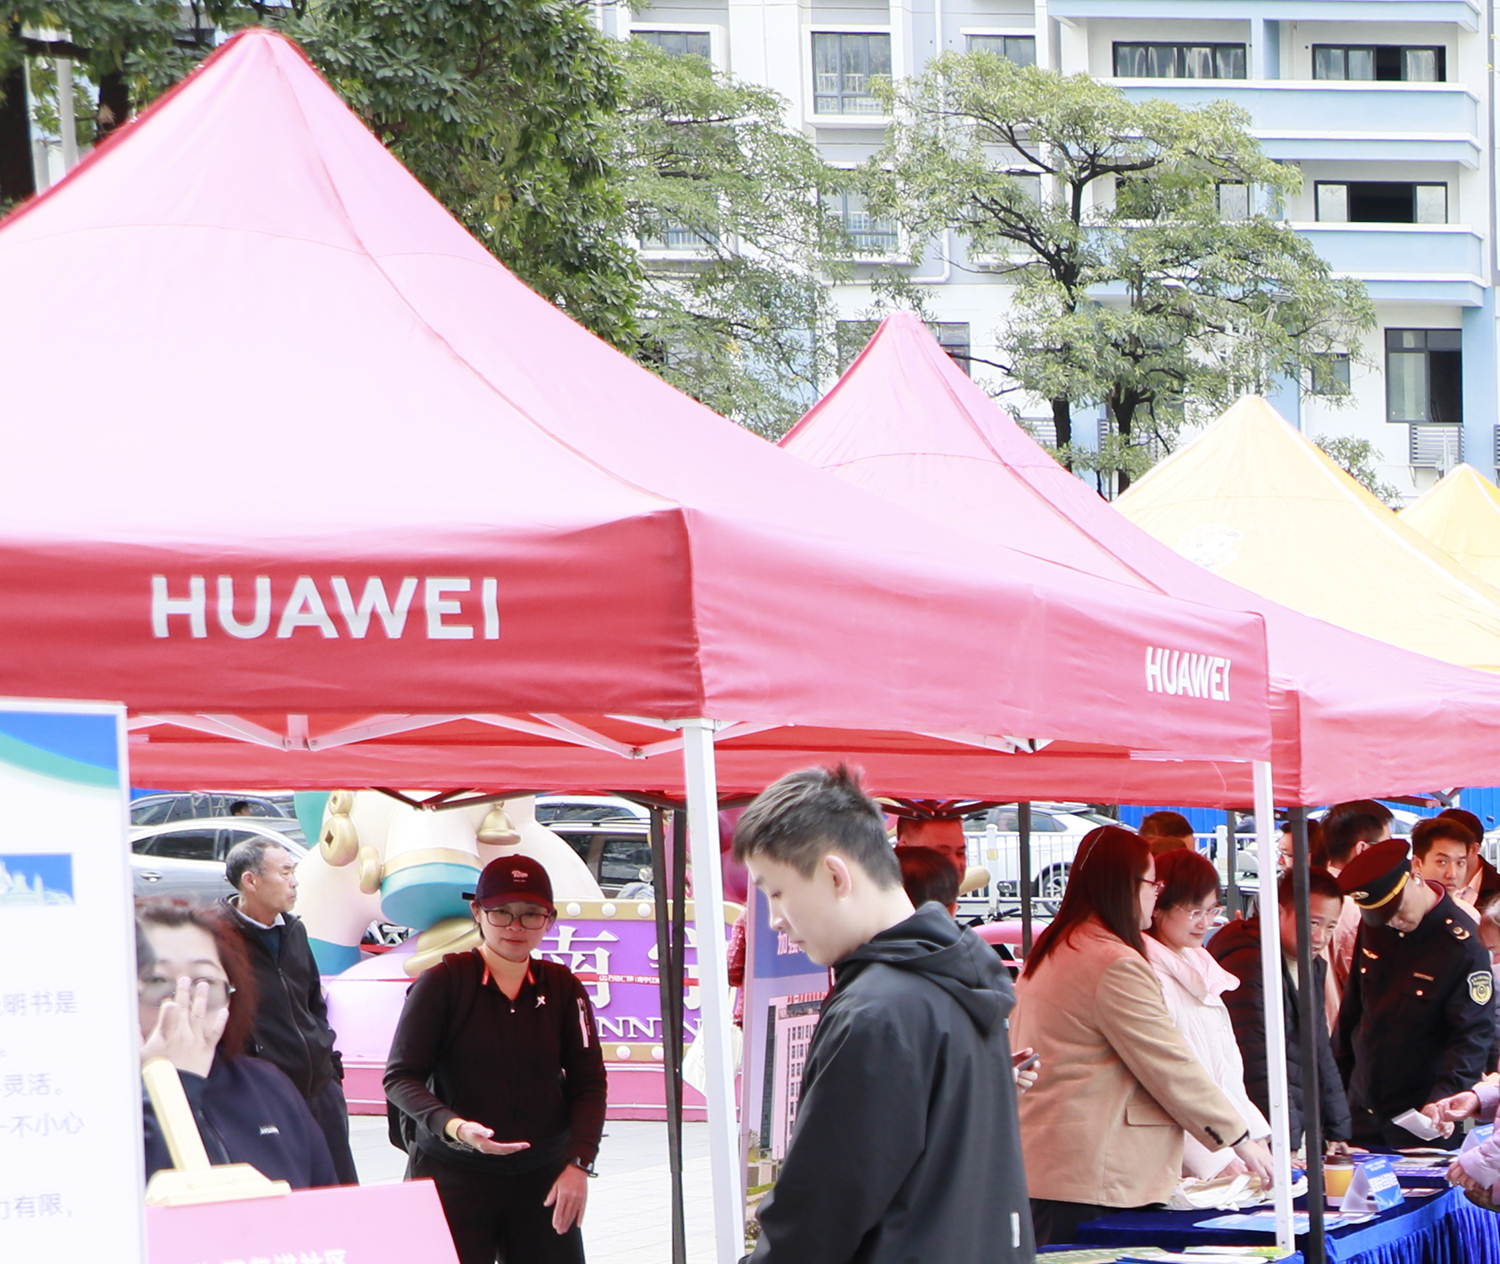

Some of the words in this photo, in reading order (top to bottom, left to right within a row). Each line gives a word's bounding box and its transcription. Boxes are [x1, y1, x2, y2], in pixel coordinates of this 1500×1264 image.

[151, 575, 500, 640] HUAWEI
[1144, 646, 1232, 702] HUAWEI
[0, 990, 79, 1017] 明书是
[0, 1072, 64, 1097] 灵活。
